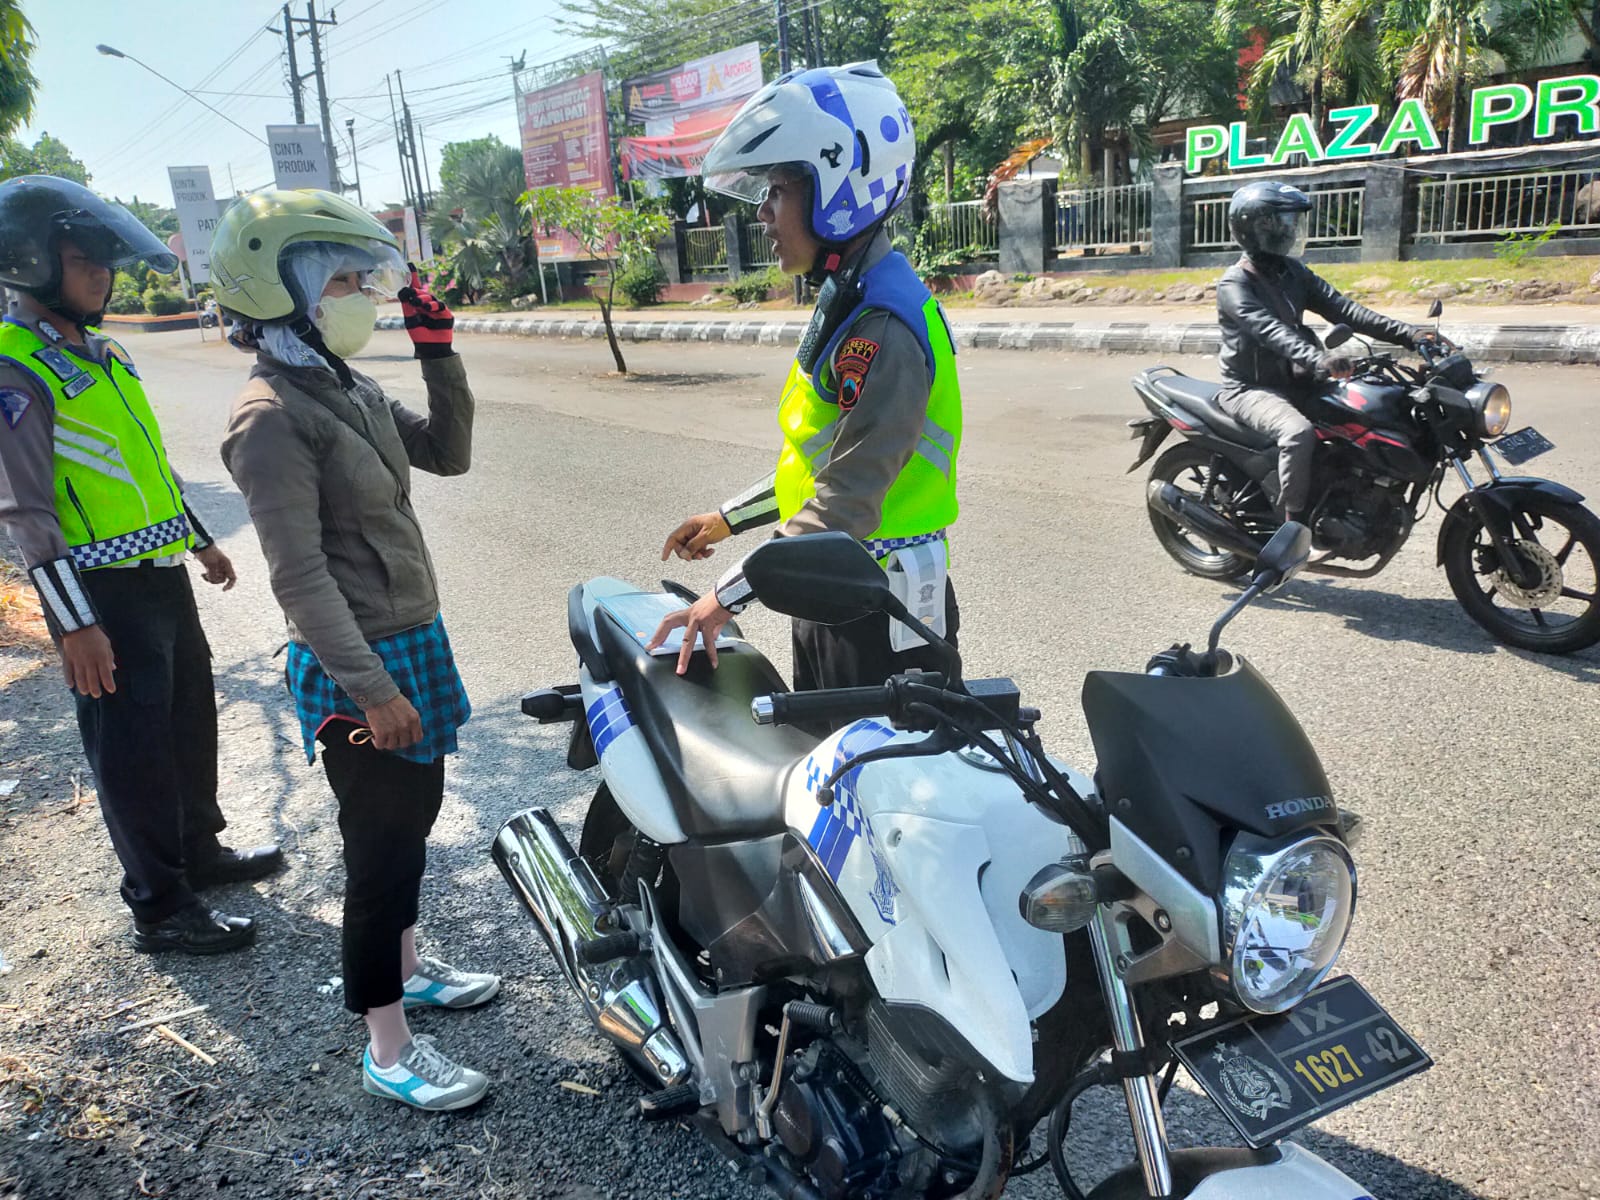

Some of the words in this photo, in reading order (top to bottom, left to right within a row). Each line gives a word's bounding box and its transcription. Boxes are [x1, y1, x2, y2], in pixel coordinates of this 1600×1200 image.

[1186, 99, 1441, 173] PLAZA
[1469, 74, 1600, 145] PR
[274, 143, 303, 156] CINTA
[277, 159, 317, 173] PRODUK
[1265, 796, 1333, 819] HONDA
[1287, 1000, 1345, 1037] IX
